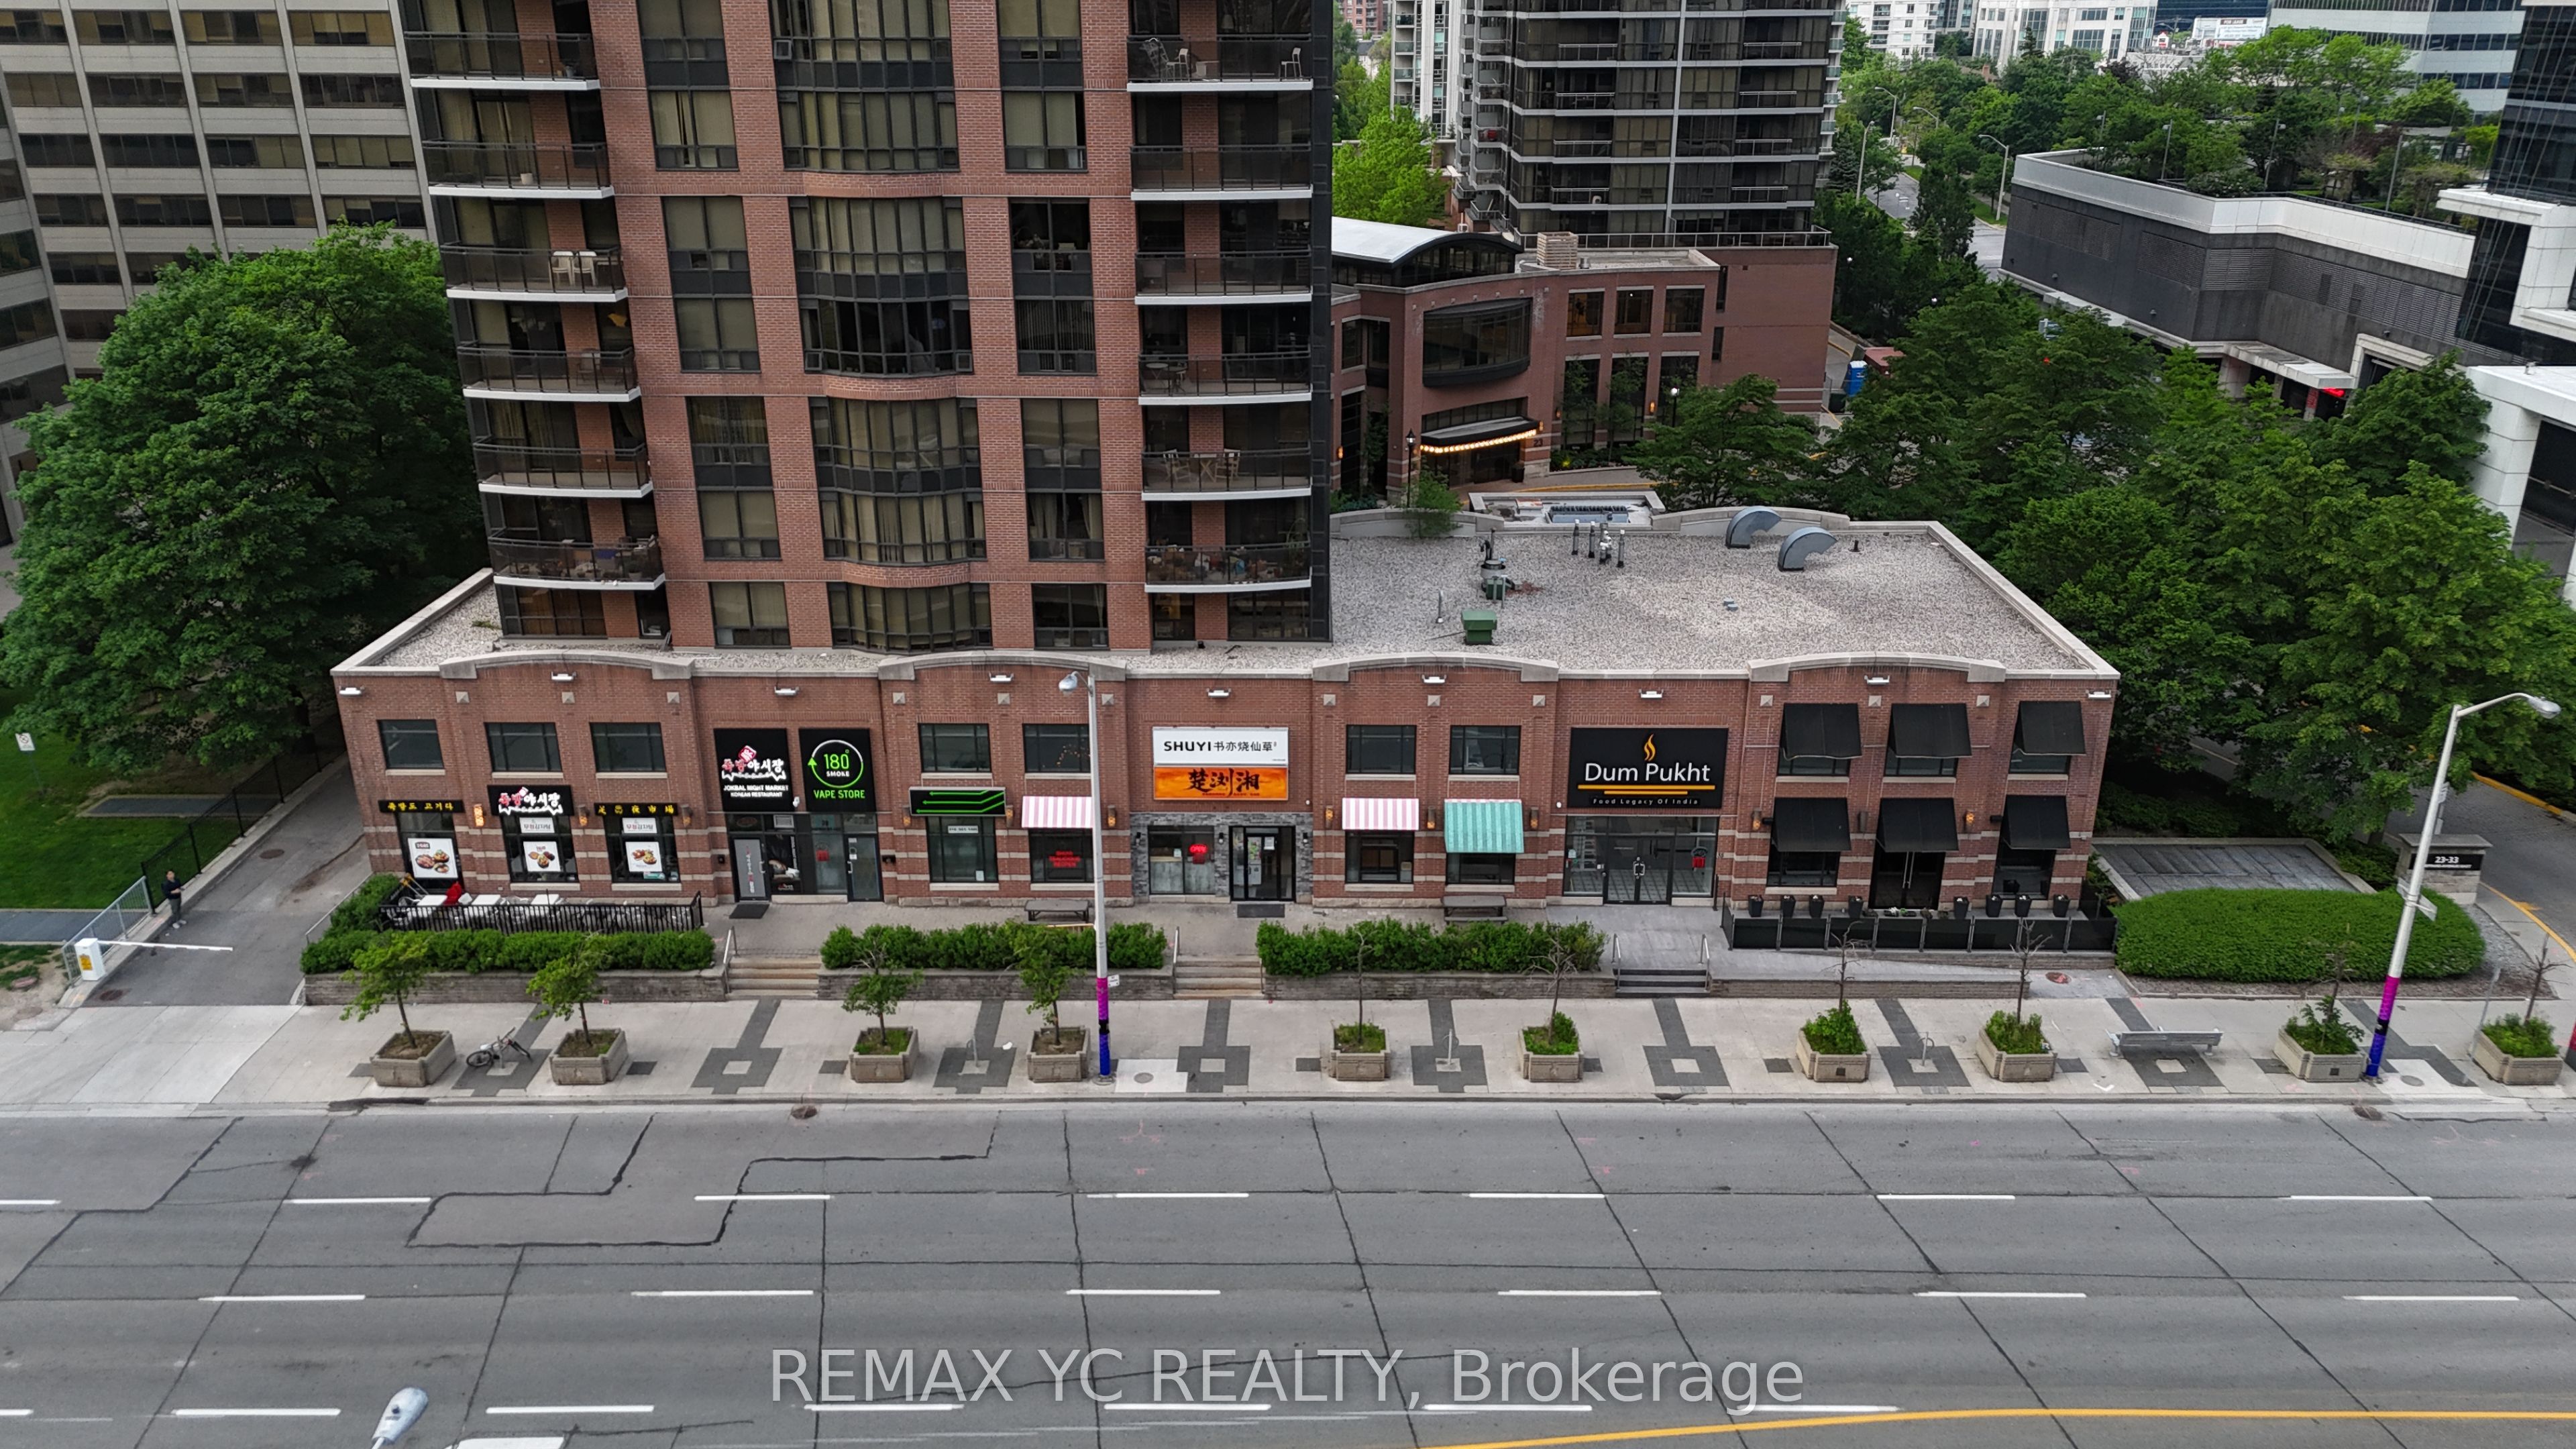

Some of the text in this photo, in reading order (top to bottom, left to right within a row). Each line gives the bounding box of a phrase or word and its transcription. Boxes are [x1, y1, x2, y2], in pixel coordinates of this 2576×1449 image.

[1164, 741, 1273, 751] SHUYI 书亦烧仙草
[1585, 762, 1711, 782] Dum Pukht
[813, 790, 865, 798] VAPE STORE
